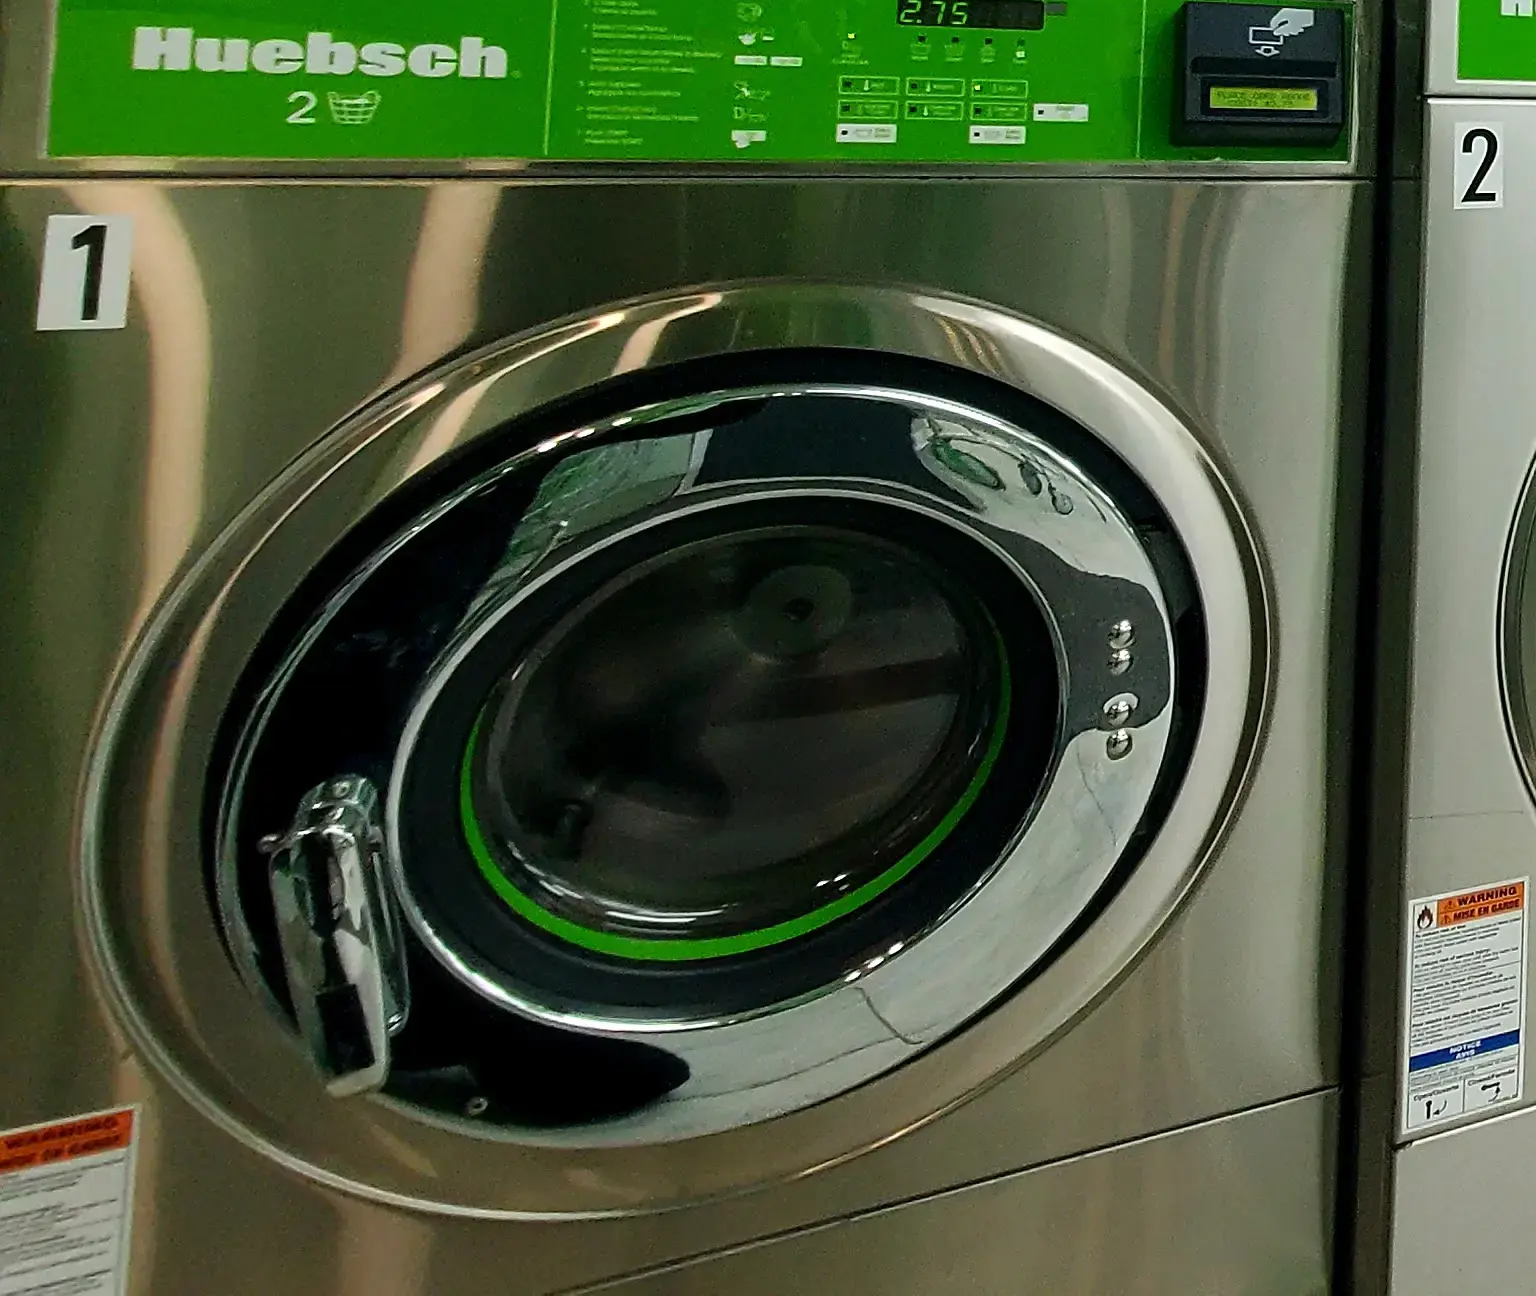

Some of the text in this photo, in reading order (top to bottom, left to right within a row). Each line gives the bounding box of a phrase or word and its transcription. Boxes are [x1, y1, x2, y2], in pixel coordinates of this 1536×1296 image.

[132, 25, 509, 80] Huebsch
[285, 90, 318, 125] 2
[1460, 127, 1499, 204] 2
[70, 223, 108, 322] 1
[1453, 898, 1520, 922] MISE EN GARDE
[1457, 886, 1517, 906] WARNING
[1449, 1040, 1482, 1055] NOTICE
